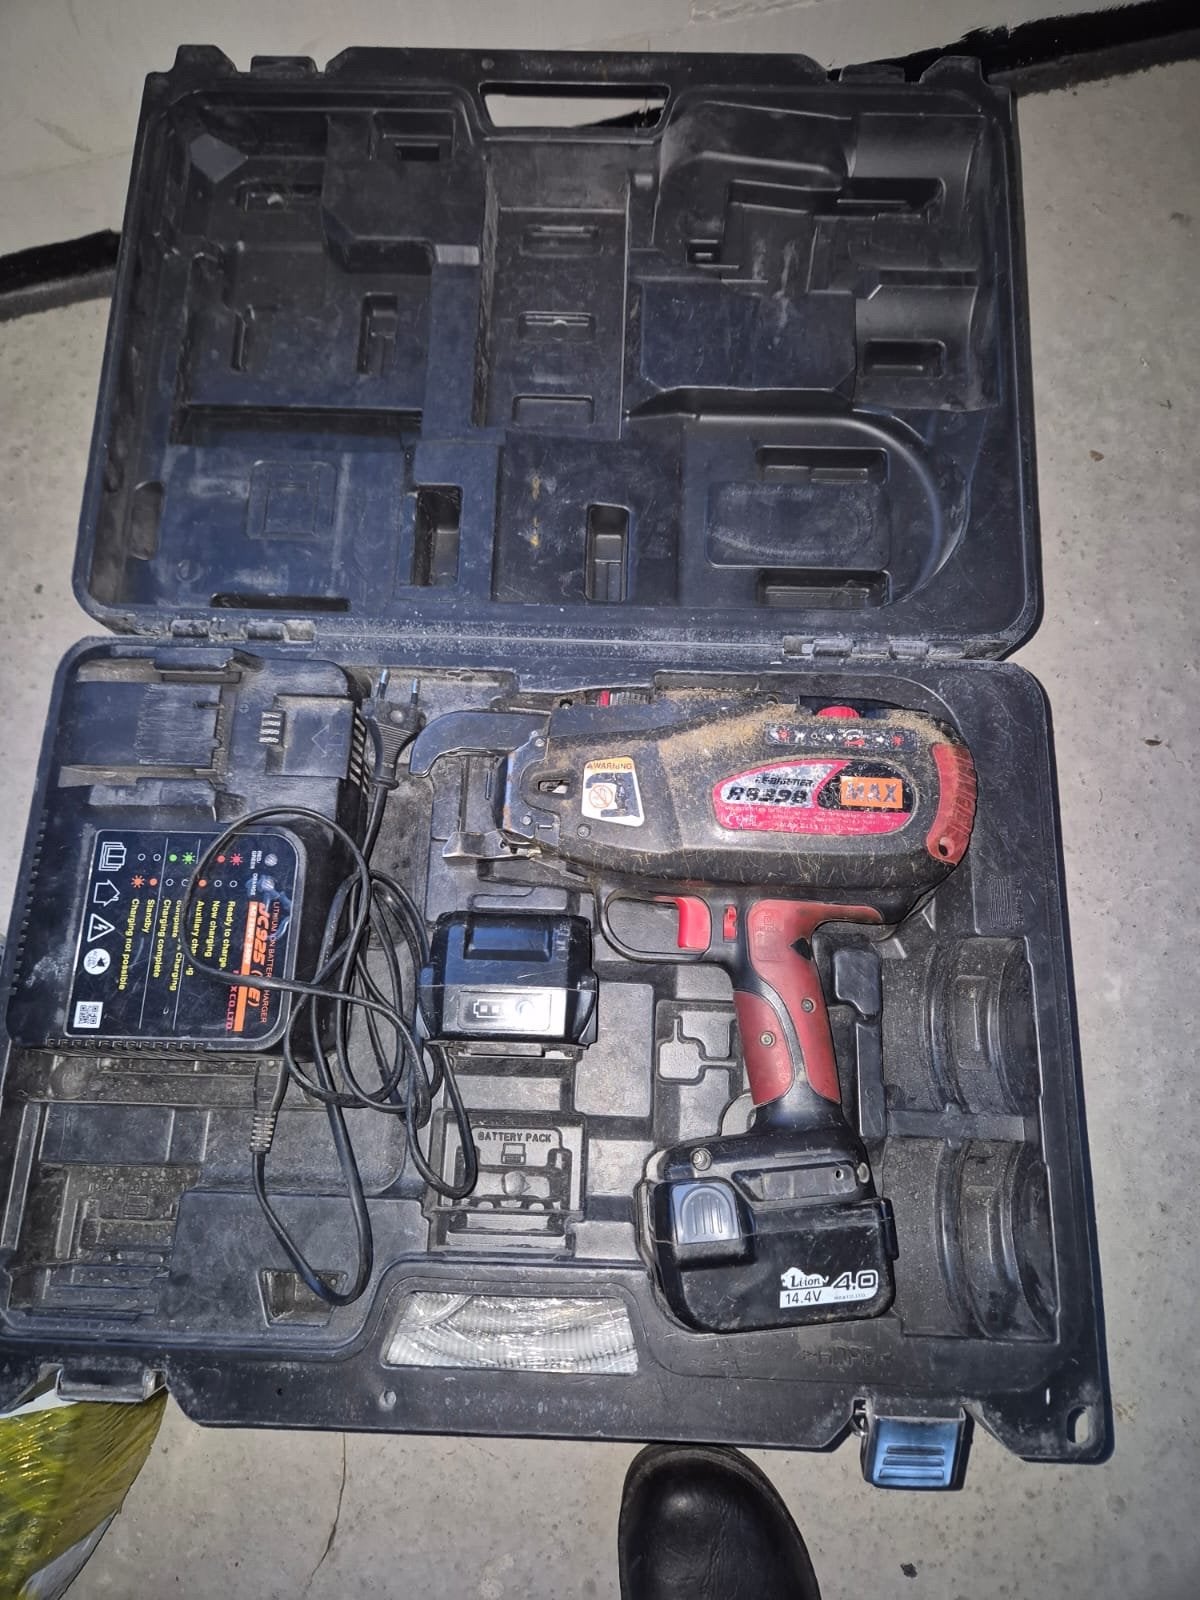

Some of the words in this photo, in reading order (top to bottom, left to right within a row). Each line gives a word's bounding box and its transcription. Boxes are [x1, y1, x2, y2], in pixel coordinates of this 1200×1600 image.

[593, 761, 632, 771] WARNING
[847, 783, 897, 803] MAX
[125, 898, 140, 938] Charging
[142, 899, 156, 933] Standby
[157, 899, 171, 938] Charging
[191, 900, 205, 937] Auxiliary
[208, 900, 221, 918] Now
[222, 900, 236, 927] Ready
[271, 901, 280, 932] LITHIUM
[203, 919, 217, 958] charging
[223, 928, 232, 938] to
[253, 902, 271, 965] JC925
[118, 953, 131, 991] possible
[153, 938, 165, 977] complete
[169, 952, 183, 991] Charging
[266, 948, 276, 979] BATTER
[260, 989, 271, 1024] HARGER
[478, 1131, 522, 1142] BATTERY
[525, 1132, 552, 1143] PACK
[831, 1269, 879, 1291] 4.0
[785, 1290, 822, 1305] 14.4V
